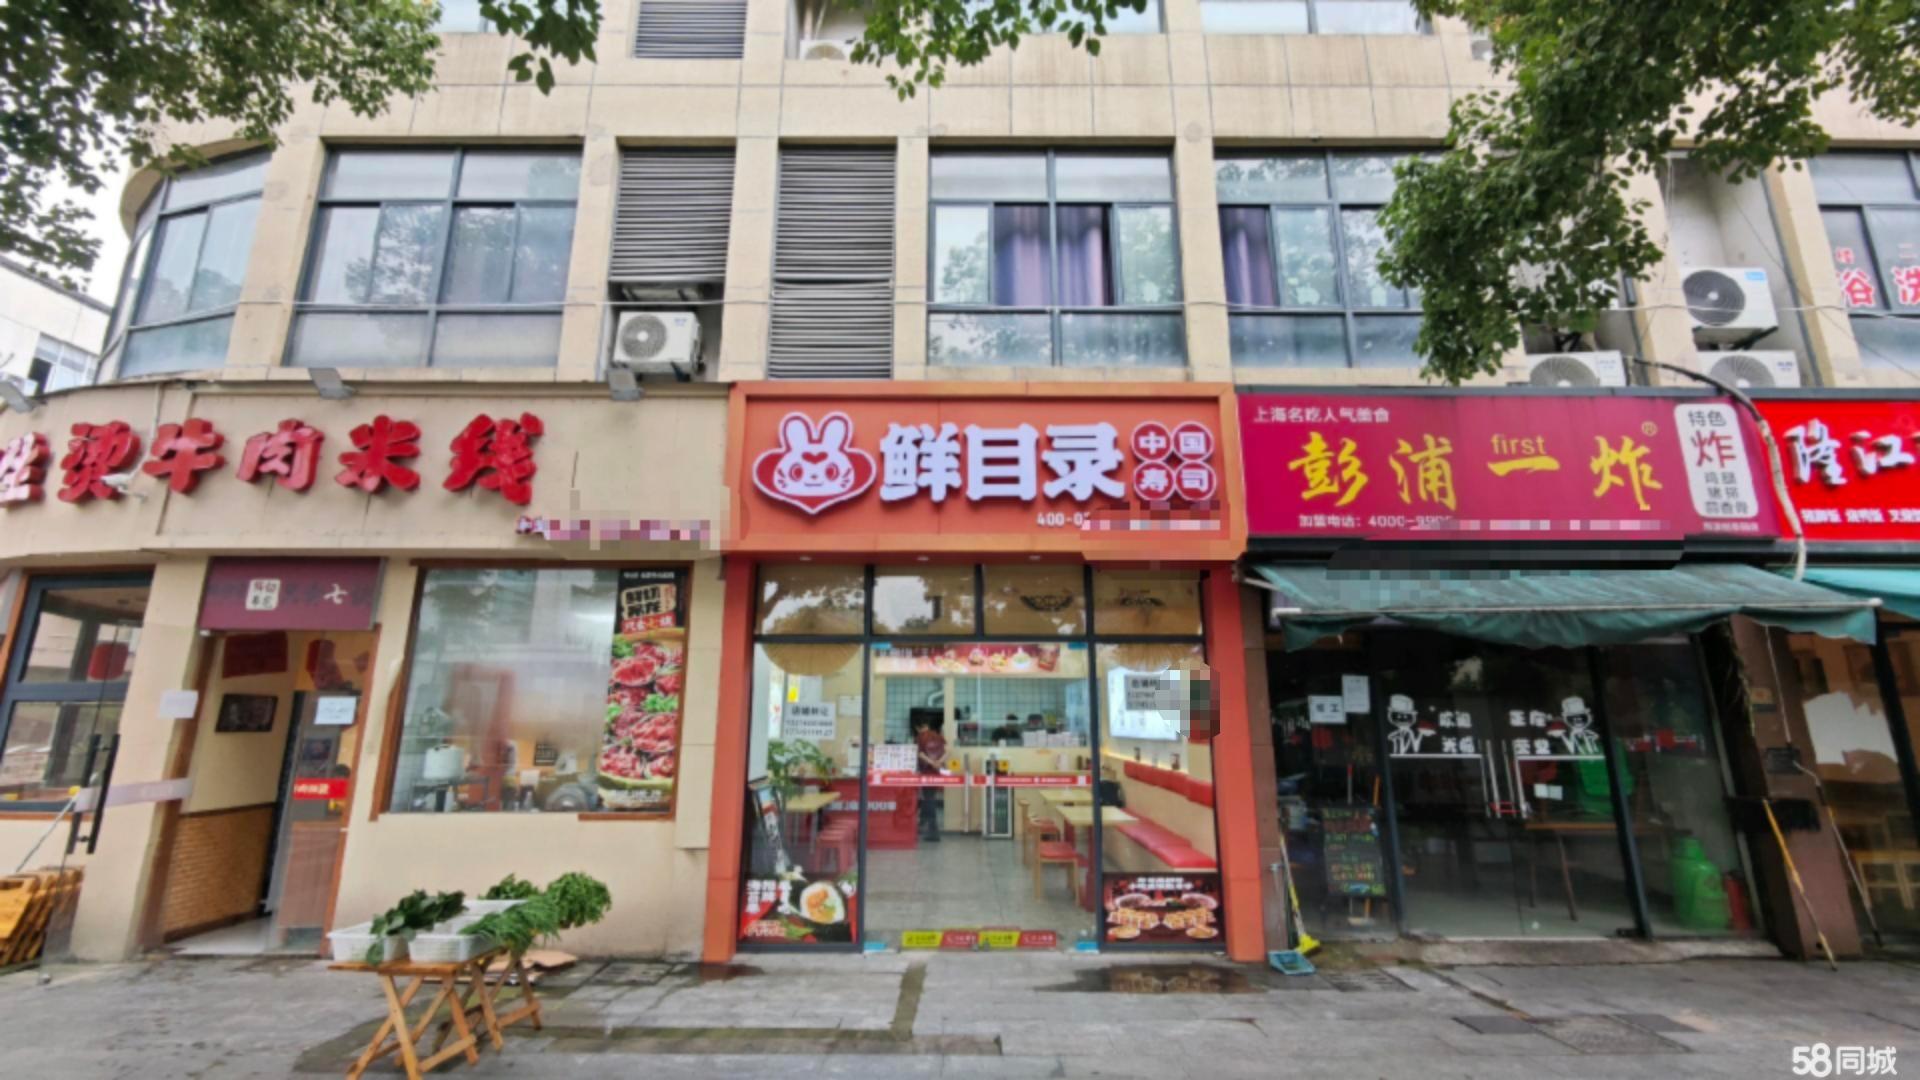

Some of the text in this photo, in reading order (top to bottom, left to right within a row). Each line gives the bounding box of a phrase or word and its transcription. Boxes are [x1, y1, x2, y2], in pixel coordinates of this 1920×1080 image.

[1688, 409, 1727, 428] 特色
[879, 422, 1208, 502] 鲜目录 中国
[1491, 433, 1546, 456] first
[1691, 430, 1736, 468] 炸
[1784, 418, 1920, 489] 隆江
[1137, 466, 1210, 493] 寿司
[1288, 431, 1663, 512] 彭浦一炸
